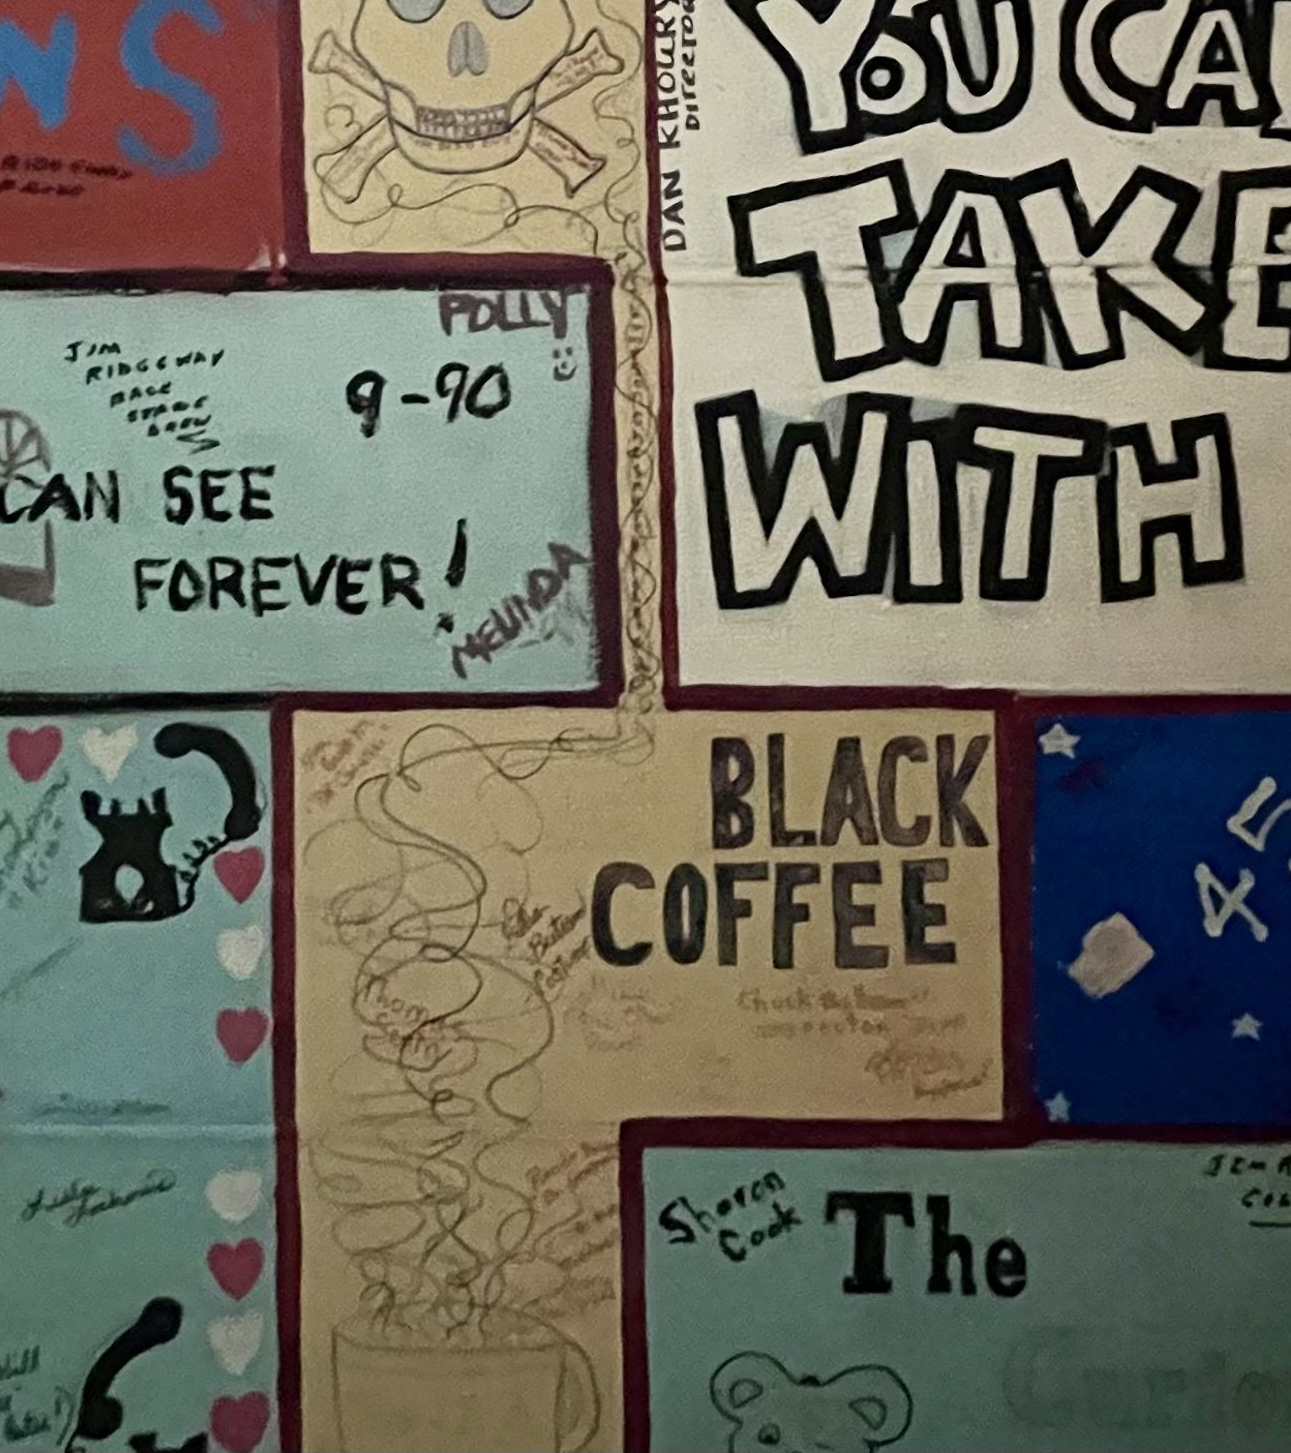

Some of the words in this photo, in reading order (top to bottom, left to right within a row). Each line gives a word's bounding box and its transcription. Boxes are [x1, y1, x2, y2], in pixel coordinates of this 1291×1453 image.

[660, 169, 688, 253] DAN
[344, 362, 512, 439] 9-90
[163, 464, 276, 526] SEE
[694, 388, 1247, 610] WITH
[711, 732, 992, 849] BLACK
[590, 857, 958, 970] COFFEE
[823, 1190, 1028, 1299] The
